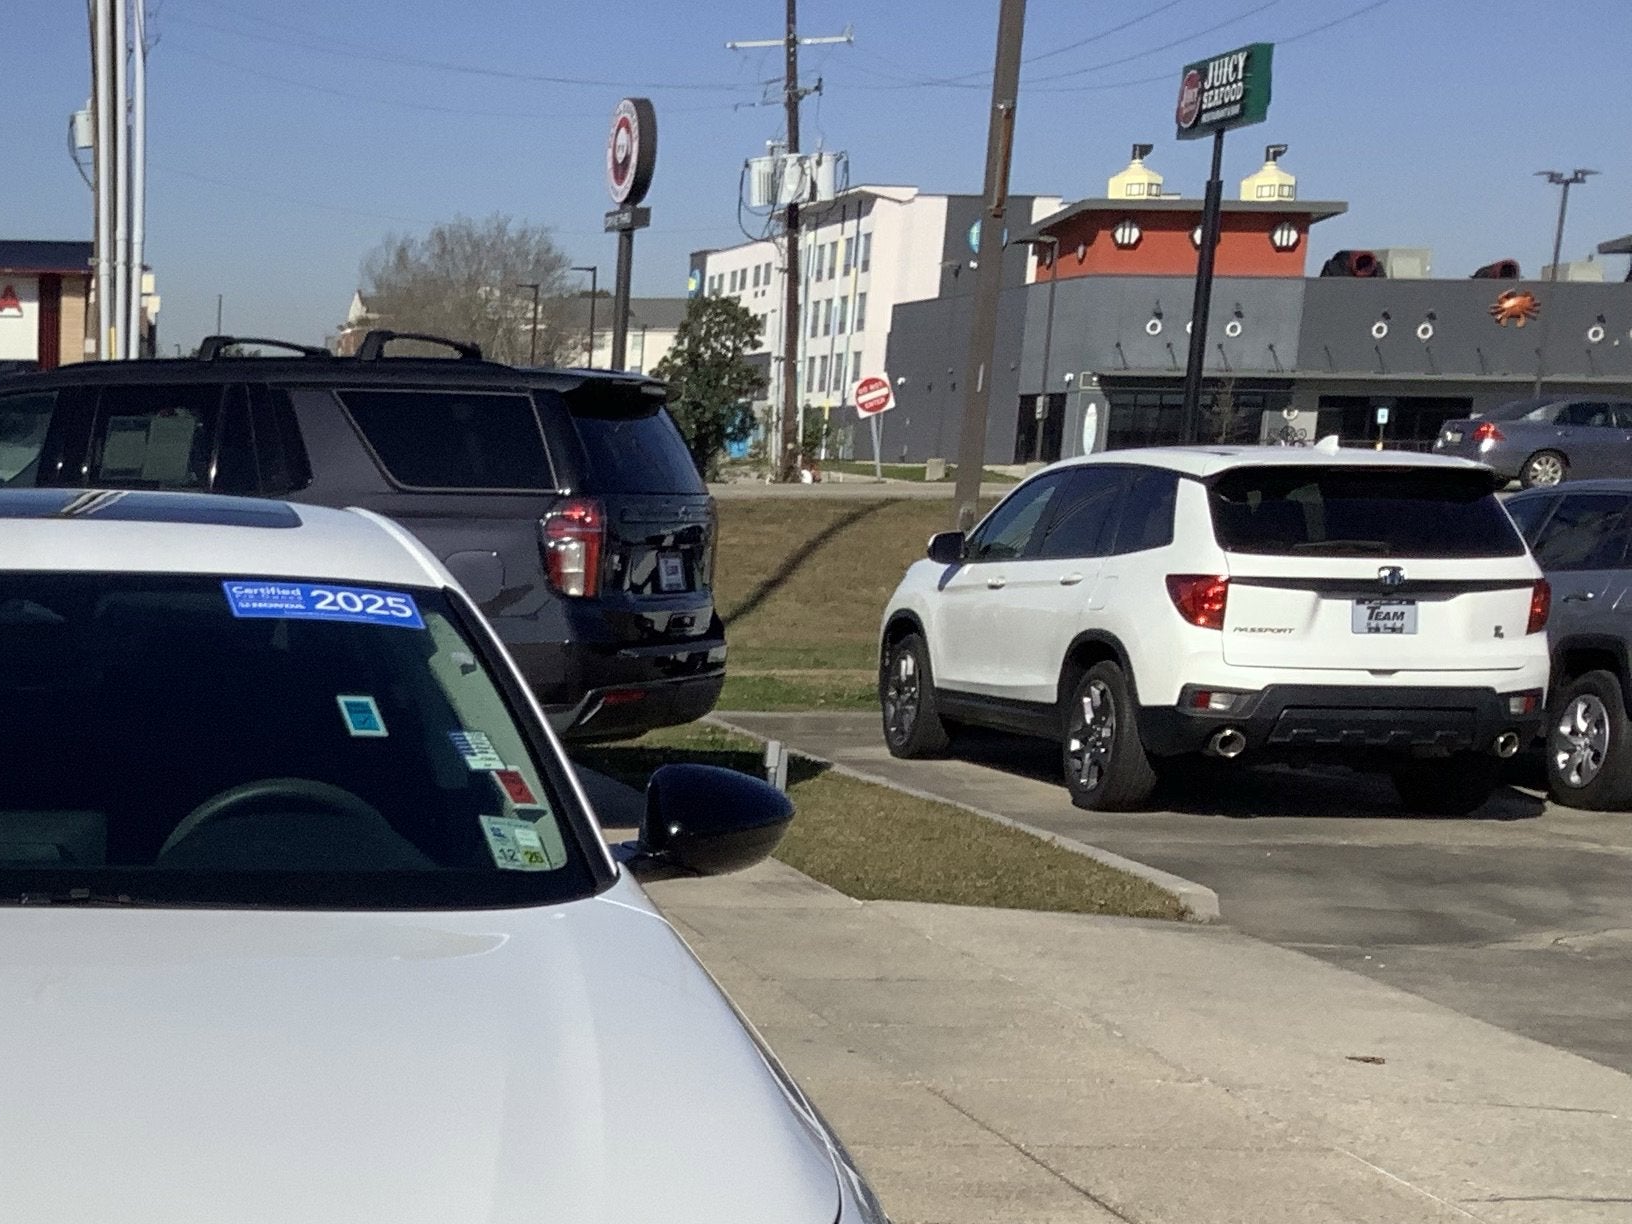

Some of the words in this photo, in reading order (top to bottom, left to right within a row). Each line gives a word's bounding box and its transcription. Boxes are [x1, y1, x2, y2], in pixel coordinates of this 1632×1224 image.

[1204, 51, 1248, 89] JUICY
[1201, 81, 1244, 110] SEAFOOD
[864, 397, 886, 409] ENTER
[232, 586, 302, 596] Certified
[310, 589, 413, 618] 2025
